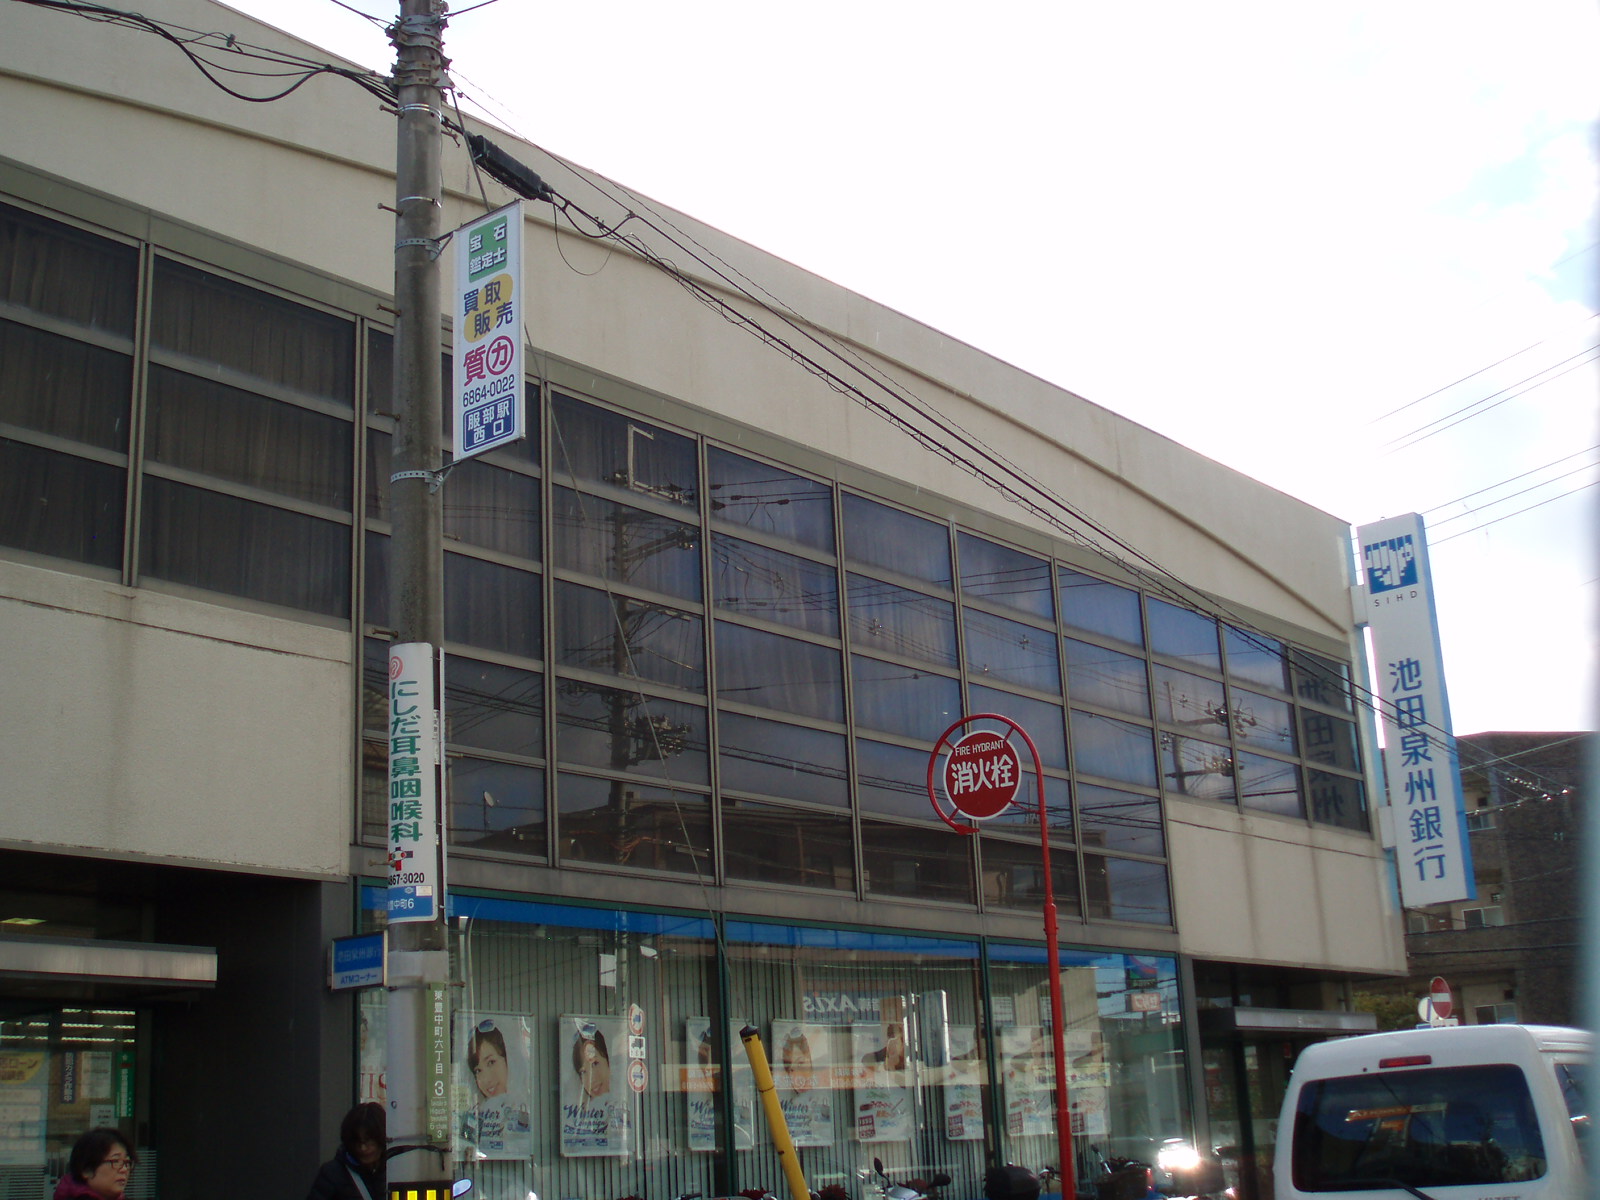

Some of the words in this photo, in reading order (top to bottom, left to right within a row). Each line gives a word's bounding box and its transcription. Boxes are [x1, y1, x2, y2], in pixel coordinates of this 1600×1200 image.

[470, 247, 507, 275] 鑑定士
[463, 280, 501, 317] 買取
[473, 301, 513, 338] 販売
[463, 344, 486, 387] 質
[463, 374, 515, 407] 6864-0022
[468, 400, 510, 431] 服部駅
[473, 419, 504, 443] 西口
[390, 680, 423, 843] にしだ耳鼻咽喉科
[955, 745, 971, 756] FIRE
[972, 740, 1004, 753] HYDRANT
[951, 754, 1015, 795] 消火栓
[1388, 656, 1447, 882] 池田泉州銀行
[340, 973, 377, 985] ATMコーナー
[433, 990, 444, 1074] 東豊中町六丁目
[434, 1079, 444, 1097] 3
